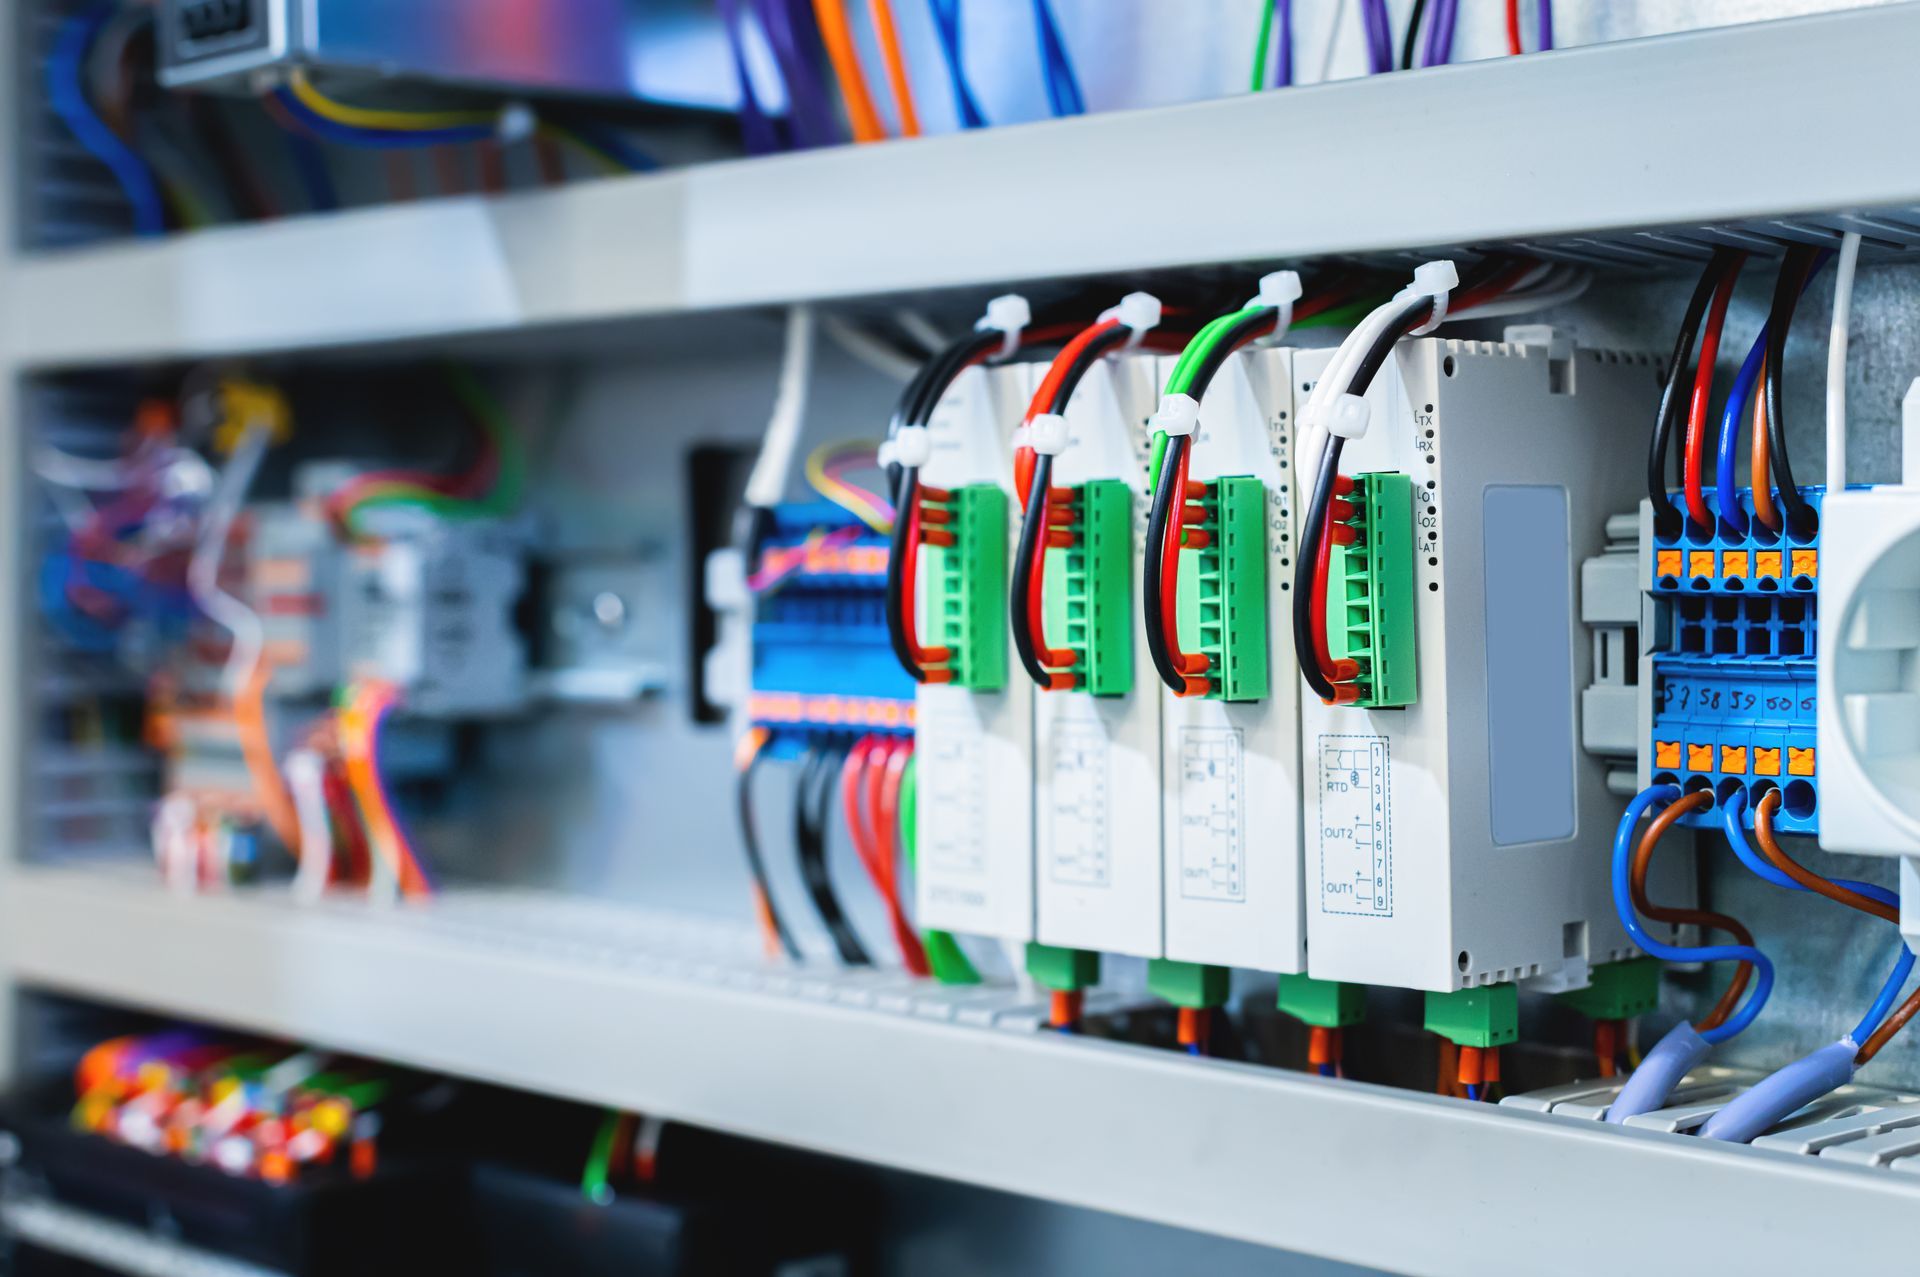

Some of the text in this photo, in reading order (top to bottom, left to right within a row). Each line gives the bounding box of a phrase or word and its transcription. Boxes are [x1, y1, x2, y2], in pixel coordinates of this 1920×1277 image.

[1418, 415, 1433, 426] TX
[1419, 441, 1434, 452] RX
[1423, 542, 1437, 553] AT
[1665, 683, 1690, 711] 57
[1700, 688, 1721, 710] 58
[1730, 691, 1757, 711] 59
[1801, 697, 1817, 712] 6
[1375, 747, 1379, 757] 1
[1374, 766, 1381, 777] 2
[1327, 782, 1348, 793] RTD
[1375, 784, 1381, 795] 3
[1375, 802, 1381, 812] 4
[1375, 821, 1382, 832] 5
[1324, 827, 1353, 839] OUT2
[1376, 840, 1382, 850] 6
[1377, 858, 1382, 868] 7
[1326, 882, 1353, 894] OUT1
[1377, 877, 1383, 888] 8
[1377, 896, 1384, 907] 9
